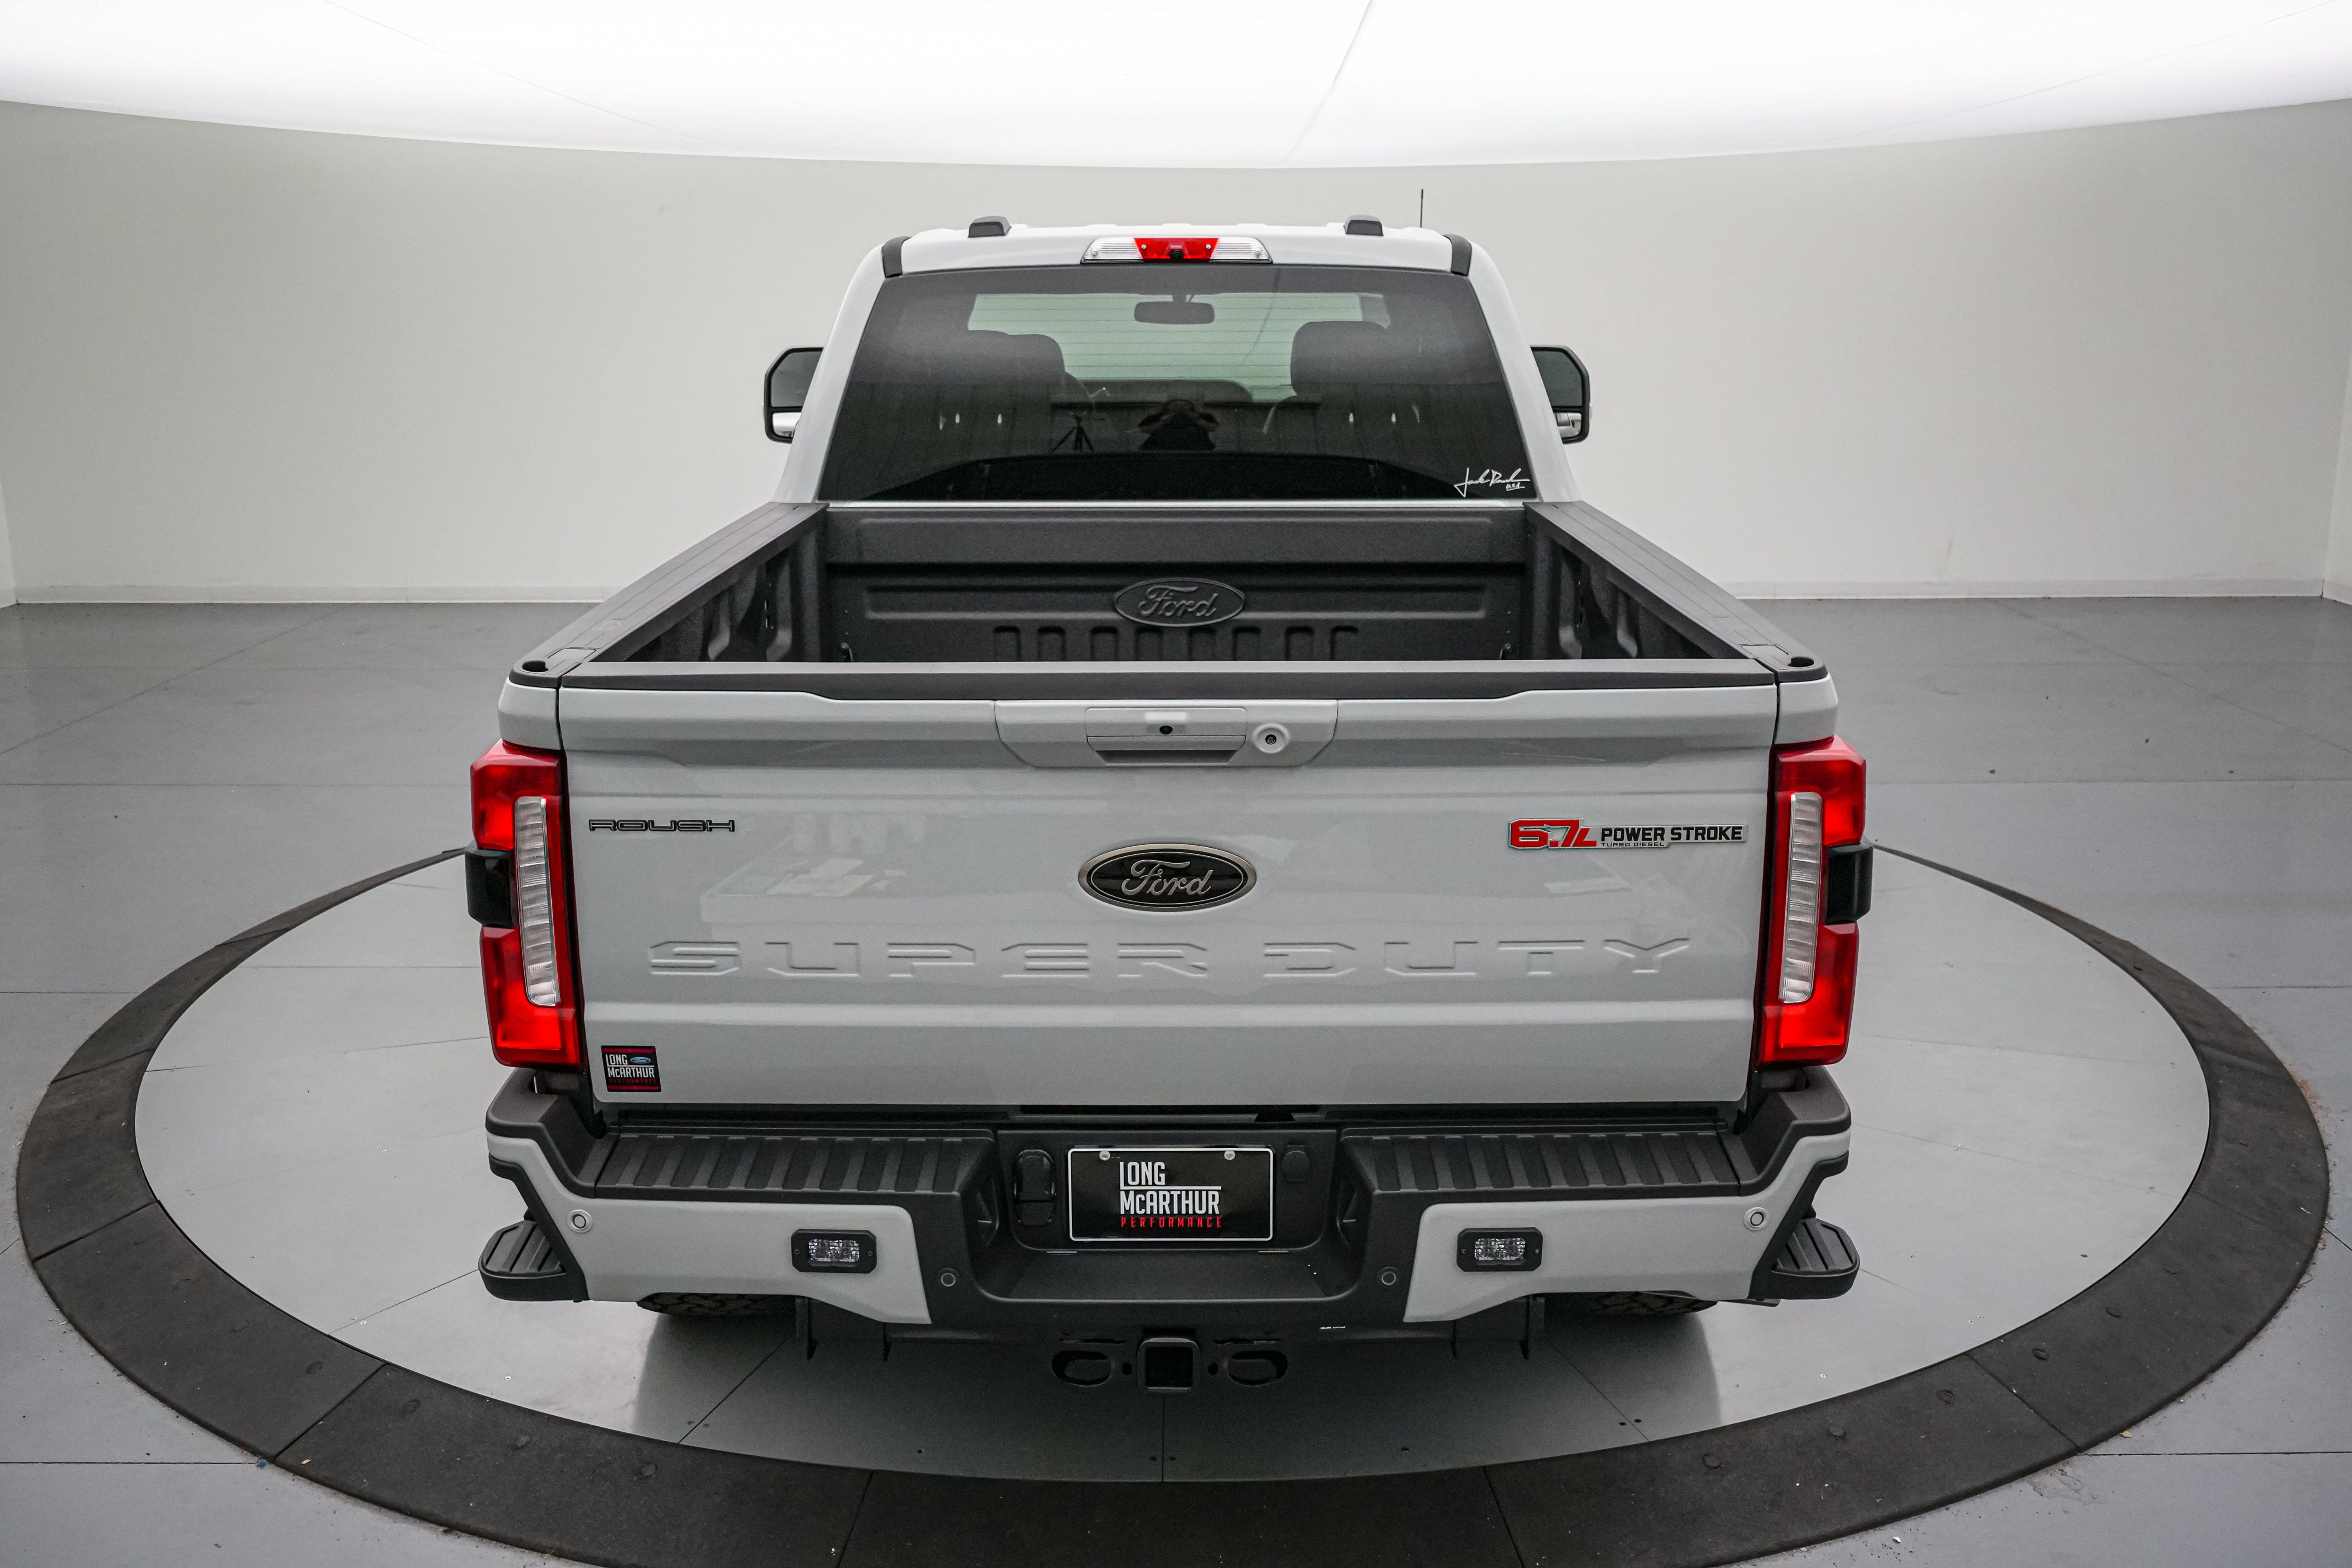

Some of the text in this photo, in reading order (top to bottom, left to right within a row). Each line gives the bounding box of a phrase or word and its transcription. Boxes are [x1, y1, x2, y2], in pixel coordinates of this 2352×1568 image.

[1138, 585, 1218, 617] Ford
[589, 819, 735, 832] ROUSH
[1510, 819, 1743, 847] 6.7L POWER STROKE
[1121, 859, 1214, 895] Ford
[648, 938, 1690, 977] SUPER DUTY
[606, 1054, 628, 1066] LONG
[608, 1067, 655, 1078] McARTHUR
[1120, 1162, 1166, 1190] LONG
[1120, 1191, 1220, 1214] McARTHUR
[1121, 1217, 1222, 1228] PERFORMANCE
